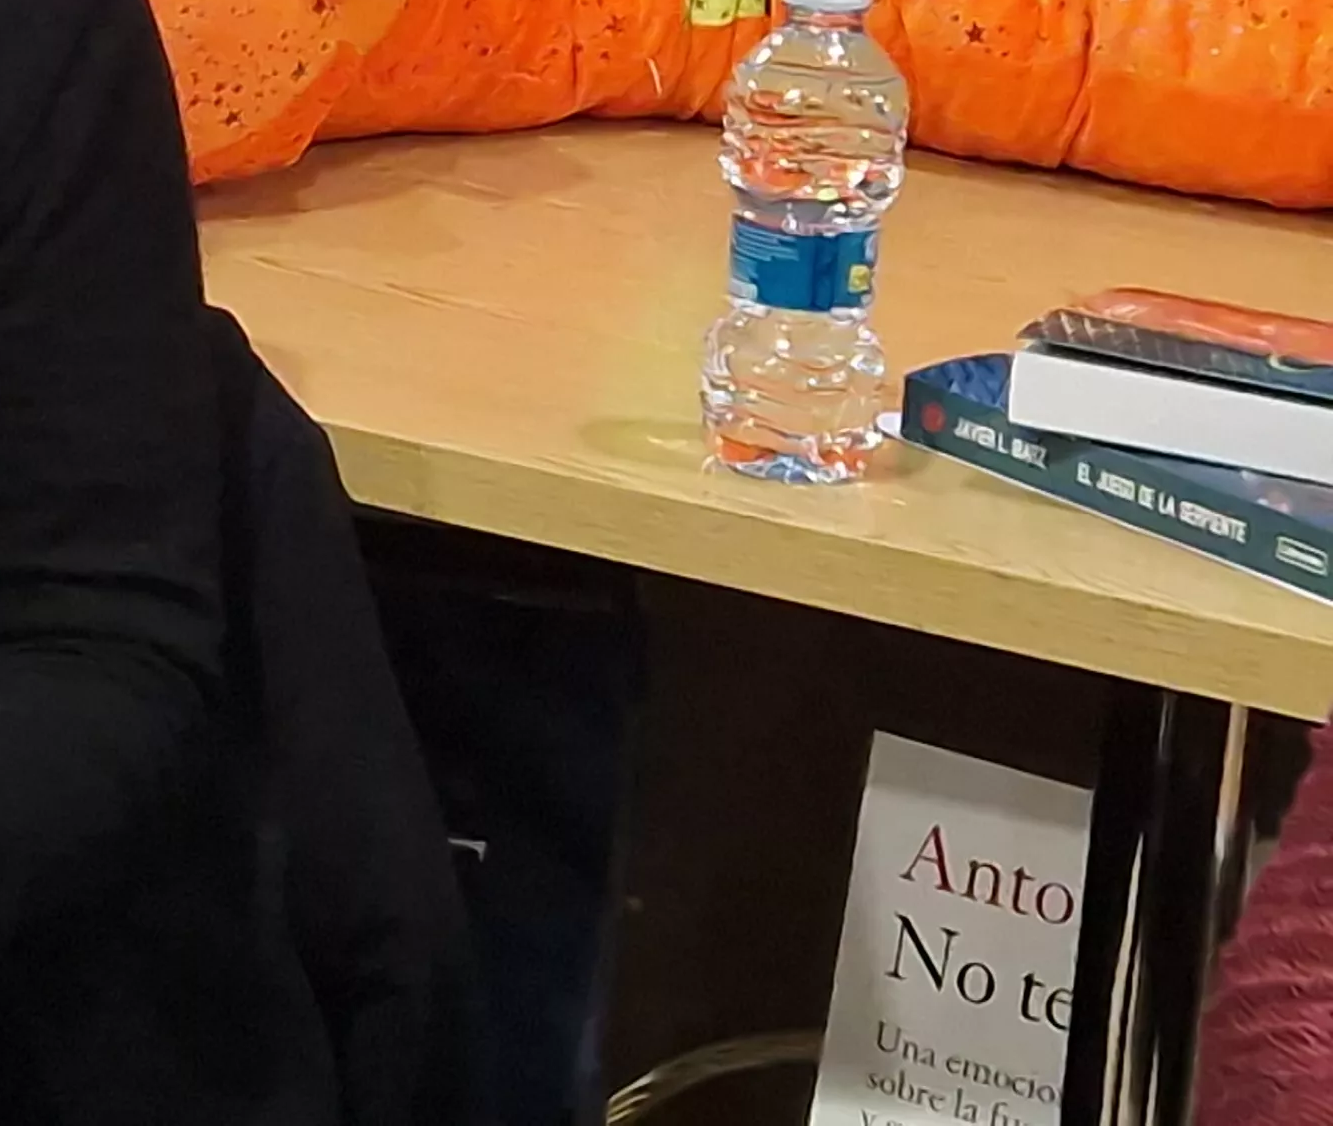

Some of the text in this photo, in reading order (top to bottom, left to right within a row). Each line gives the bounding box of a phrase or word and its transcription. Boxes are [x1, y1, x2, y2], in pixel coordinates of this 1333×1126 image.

[1076, 460, 1093, 488] EL
[1138, 483, 1156, 511] DE
[1158, 491, 1177, 519] LA
[1179, 500, 1248, 545] SERPIENTE
[898, 823, 1075, 925] Anto
[884, 911, 996, 1005] No
[866, 1069, 947, 1113] sobre
[953, 1086, 979, 1124] la
[876, 1020, 1061, 1104] Una emocio
